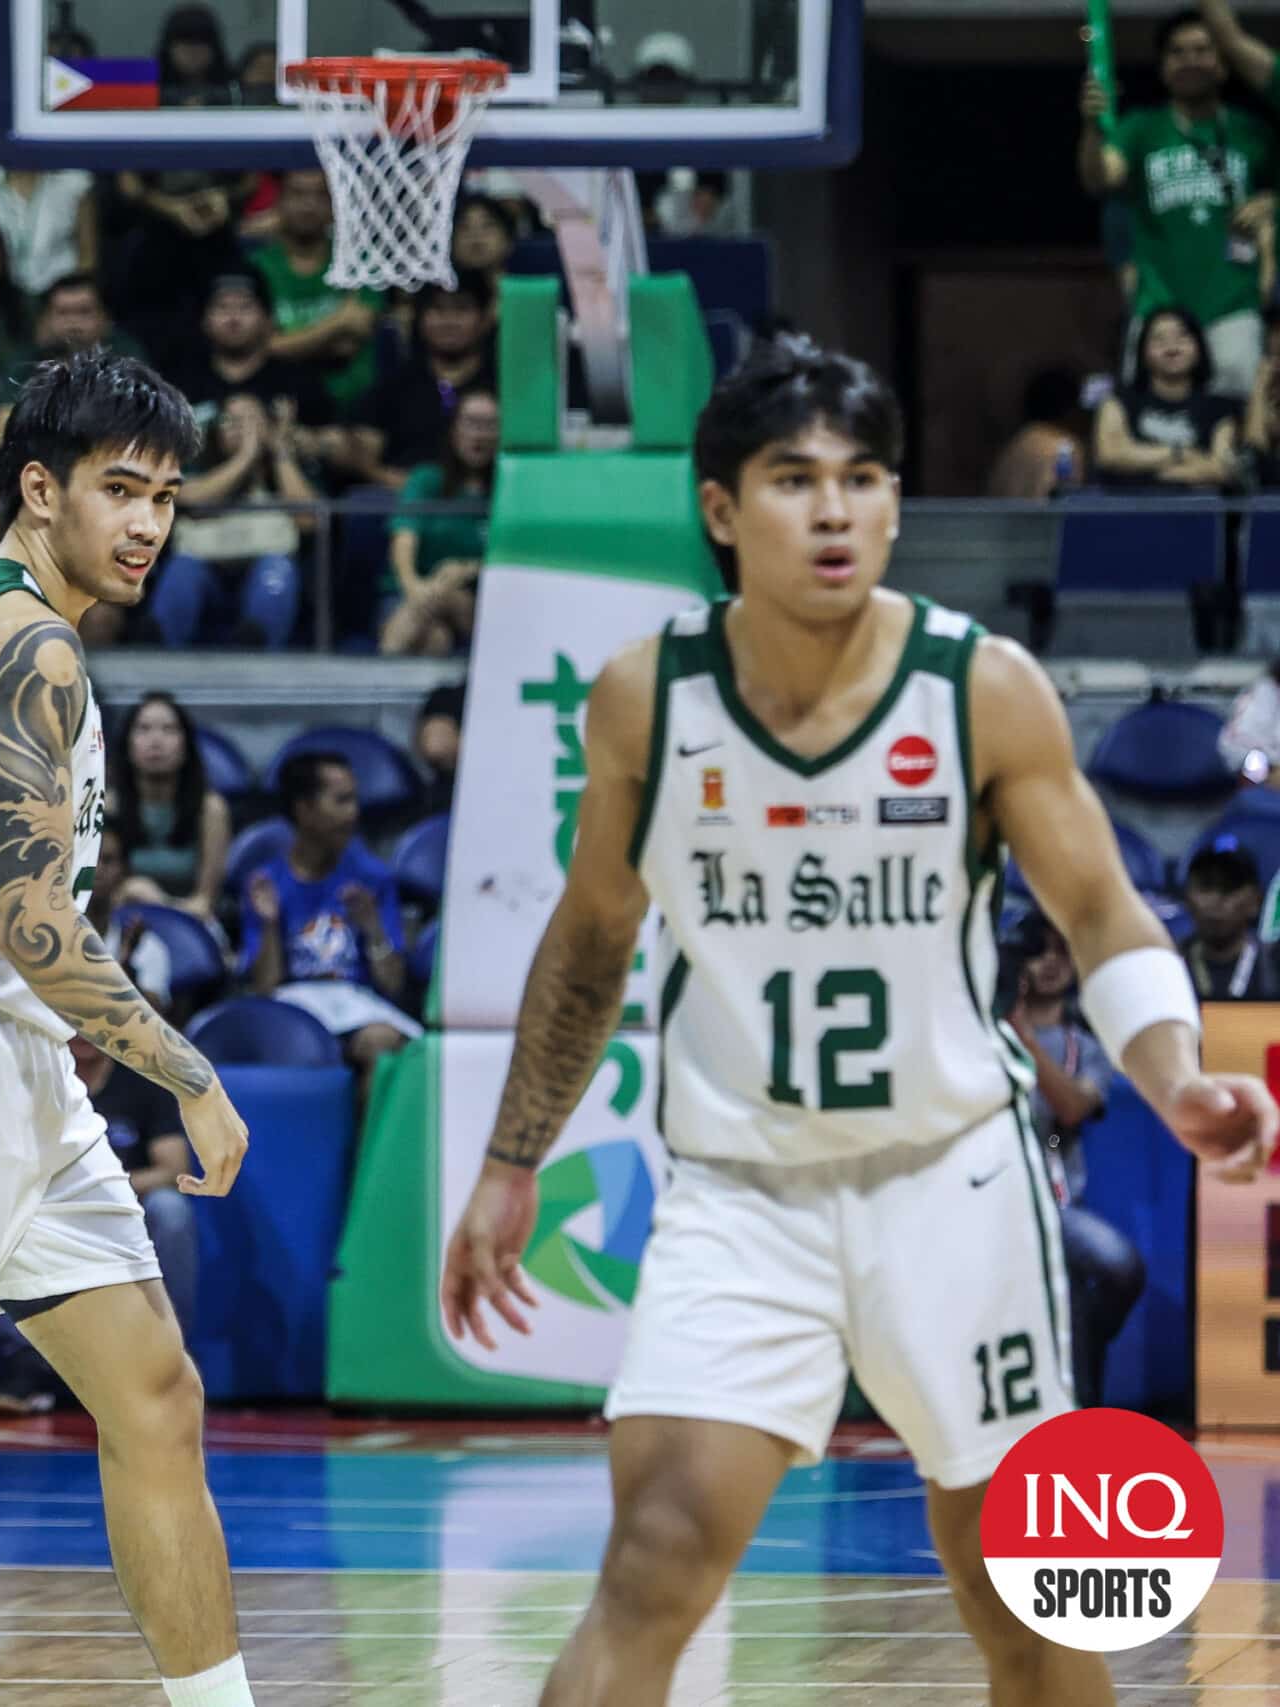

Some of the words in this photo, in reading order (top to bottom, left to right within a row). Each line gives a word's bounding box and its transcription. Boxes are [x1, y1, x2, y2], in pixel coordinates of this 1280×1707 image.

[691, 849, 770, 928] La
[786, 850, 945, 933] Salle
[762, 967, 892, 1111] 12
[974, 1332, 1041, 1425] 12
